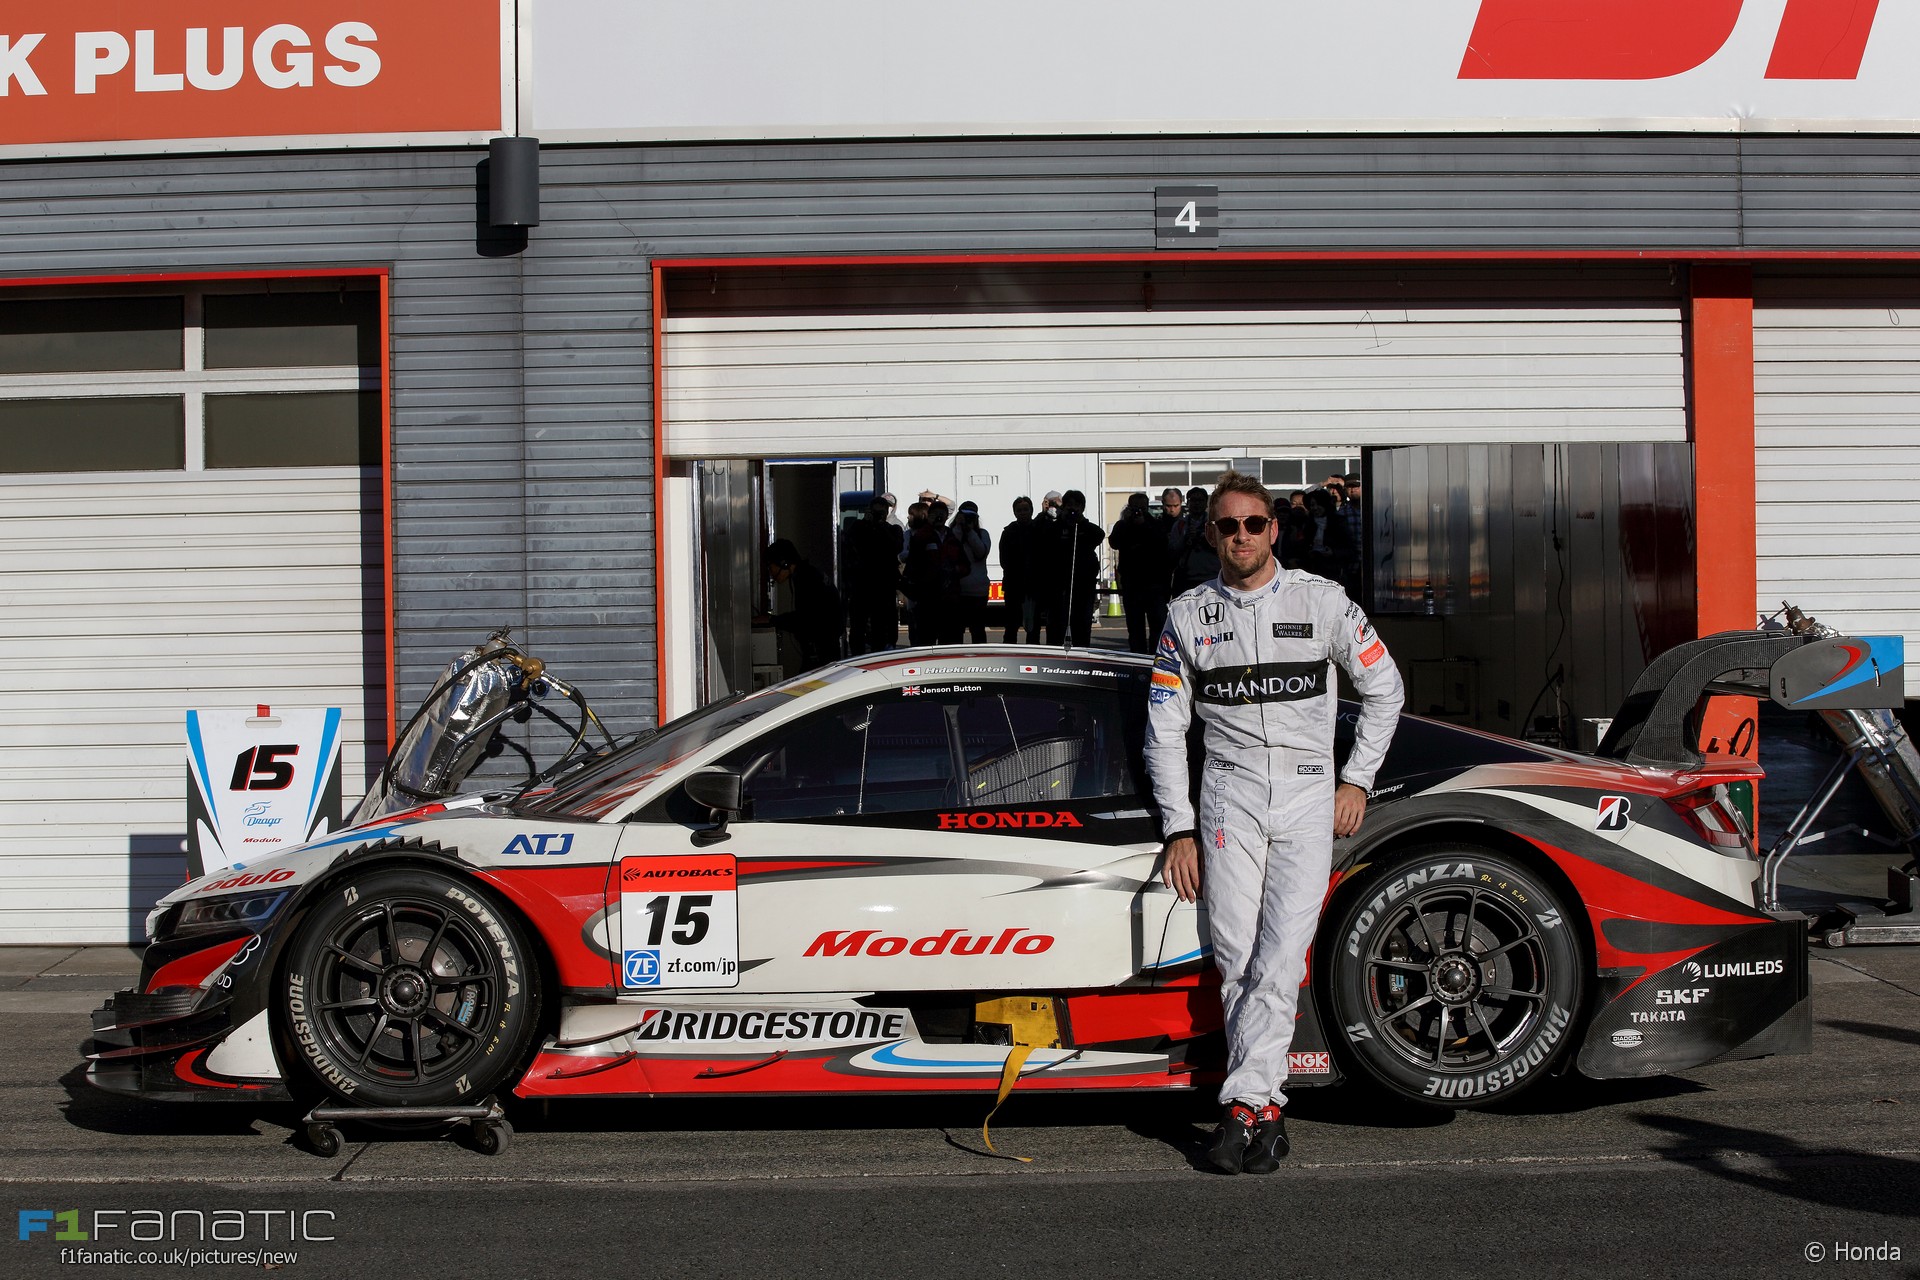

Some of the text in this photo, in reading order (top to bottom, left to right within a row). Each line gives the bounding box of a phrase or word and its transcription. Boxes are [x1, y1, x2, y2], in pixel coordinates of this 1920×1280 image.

[74, 21, 381, 94] PLUGS
[1174, 201, 1200, 233] 4
[1194, 633, 1223, 647] Mobil
[925, 665, 1008, 675] Hideki Mutoh
[1041, 666, 1131, 679] Tadasuke Makino
[920, 685, 982, 695] Jenson Button
[1151, 689, 1171, 702] SAP
[1203, 673, 1317, 699] CHANDON
[229, 744, 300, 791] 15
[937, 811, 1083, 829] HONDA
[501, 833, 575, 856] ATJ
[642, 868, 734, 879] AUTOBACS
[644, 894, 713, 946] 15
[1348, 863, 1476, 958] POTENZA
[445, 887, 521, 999] POTENZA
[803, 928, 1055, 957] Modulo
[629, 957, 657, 978] ZF
[667, 957, 736, 976] zf.com/jp
[1704, 959, 1784, 979] LUMILEDS
[1655, 987, 1710, 1005] SKF
[637, 1008, 904, 1040] BRIDGESTONE
[1630, 1010, 1686, 1023] TAKATA
[288, 973, 361, 1096] BRIDGESTONE
[1423, 1001, 1570, 1098] BRIDGESTONE
[1288, 1053, 1328, 1068] NGK
